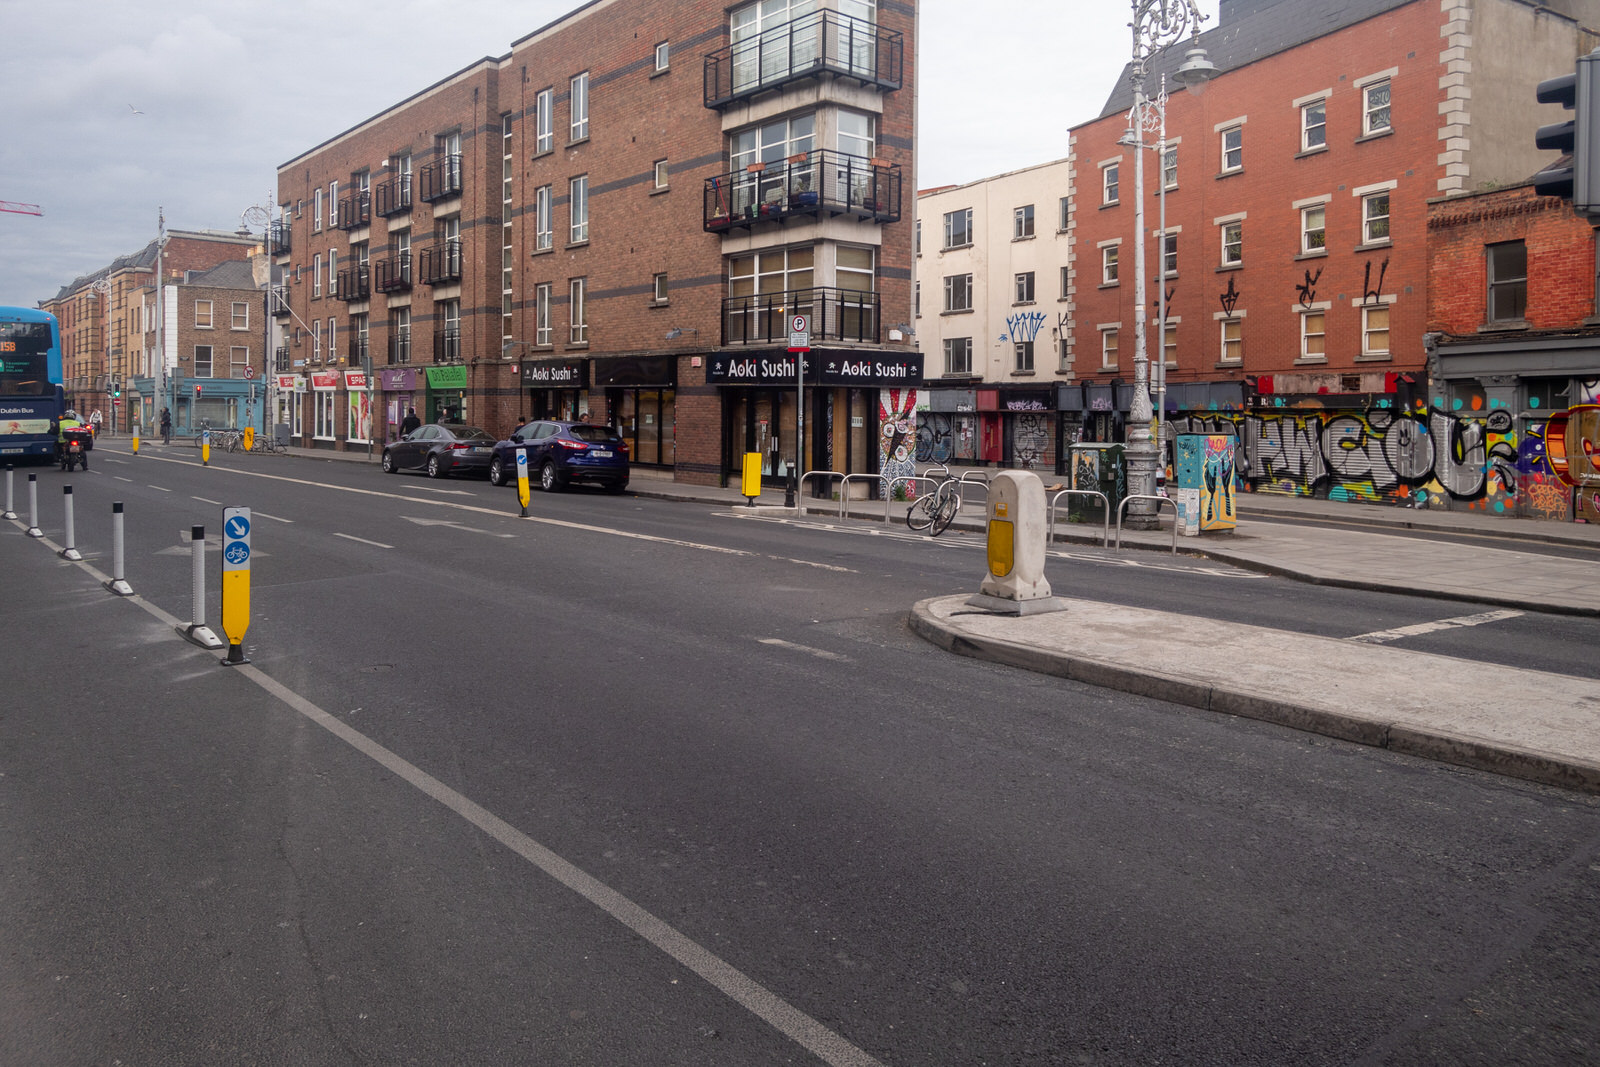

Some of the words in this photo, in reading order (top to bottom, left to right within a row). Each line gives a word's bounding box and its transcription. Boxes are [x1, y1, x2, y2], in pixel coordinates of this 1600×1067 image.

[532, 366, 550, 381] Aoki
[551, 366, 571, 380] Sushi
[728, 359, 757, 378] Aoki
[761, 358, 795, 378] Sushi
[841, 360, 871, 377] Aoki
[876, 362, 907, 378] Sushi
